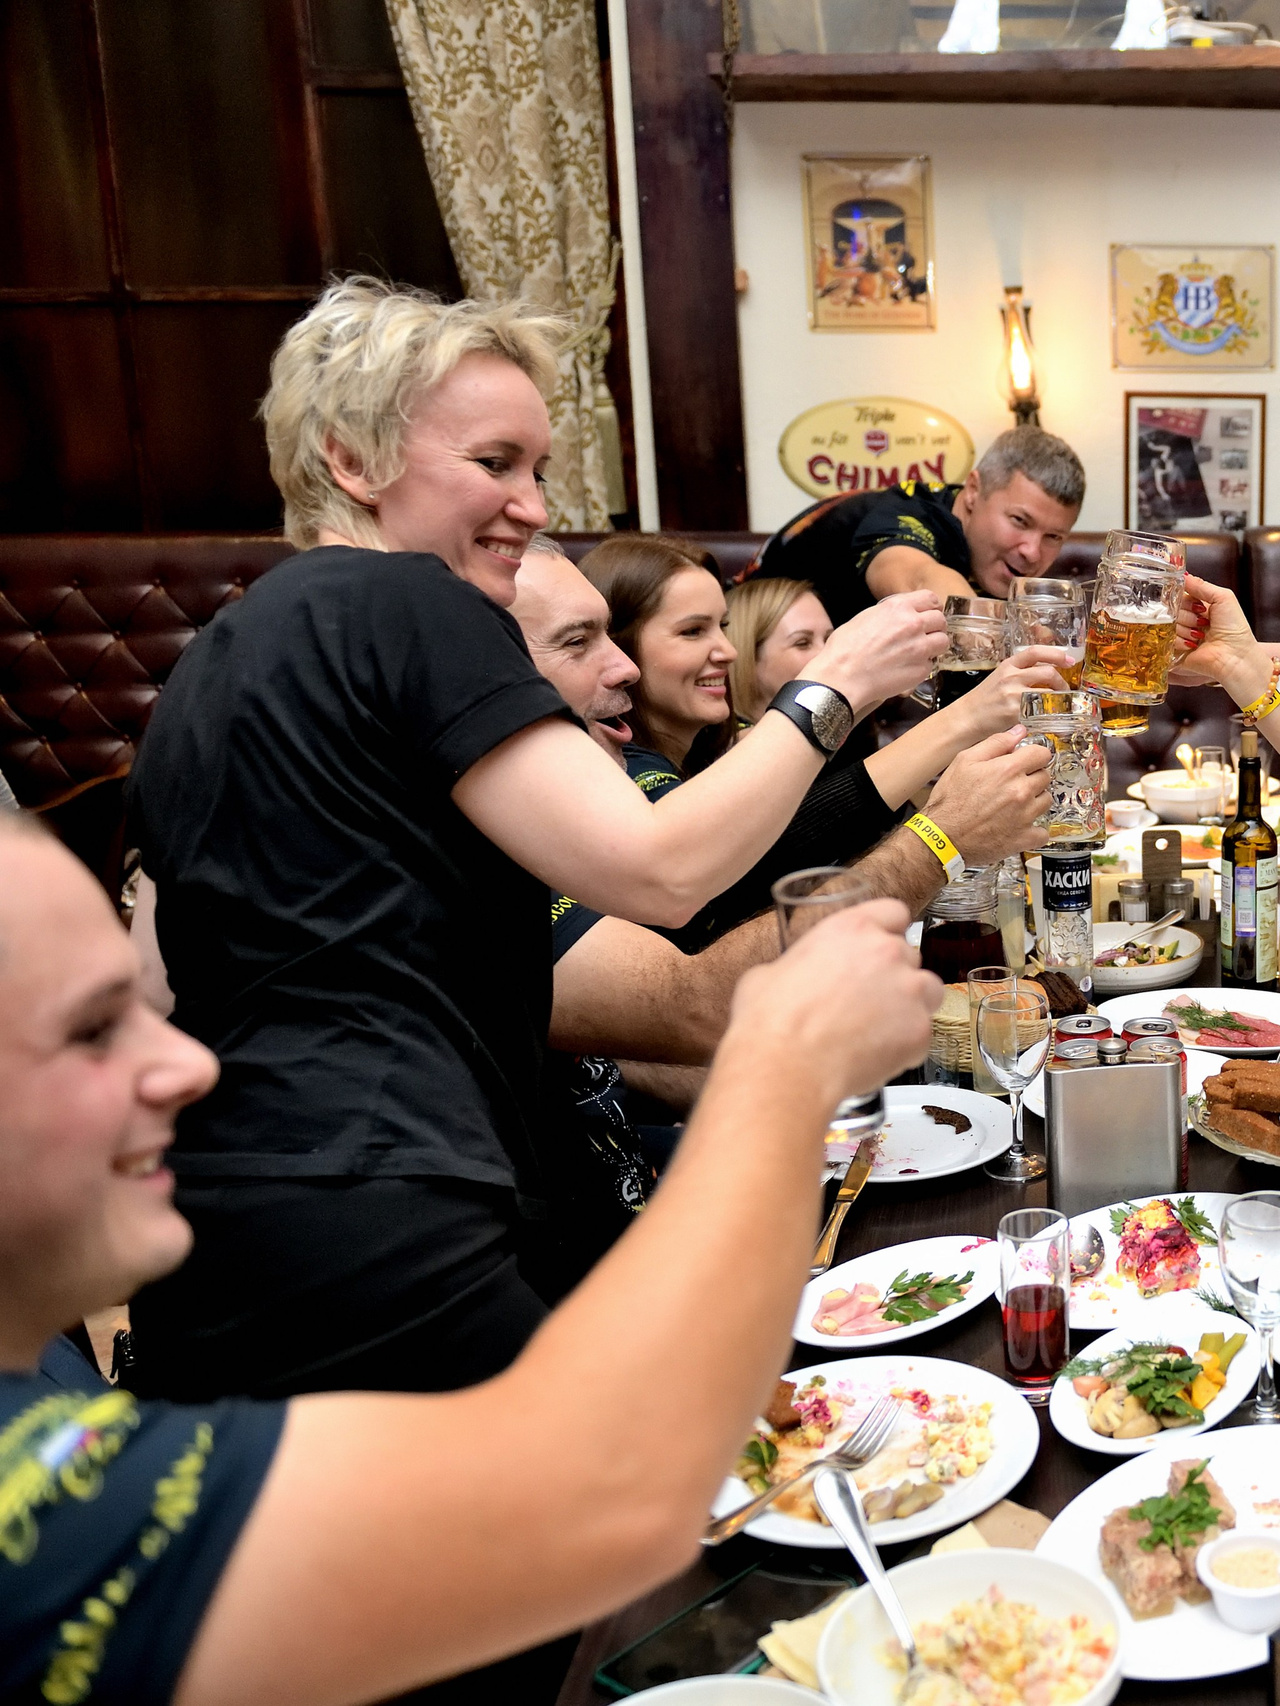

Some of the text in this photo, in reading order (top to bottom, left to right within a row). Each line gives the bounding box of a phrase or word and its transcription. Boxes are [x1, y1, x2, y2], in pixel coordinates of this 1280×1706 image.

[1183, 286, 1211, 310] HB
[807, 453, 945, 491] CHIMAY
[921, 825, 946, 850] Gold
[1045, 869, 1090, 888] ХАСКИ
